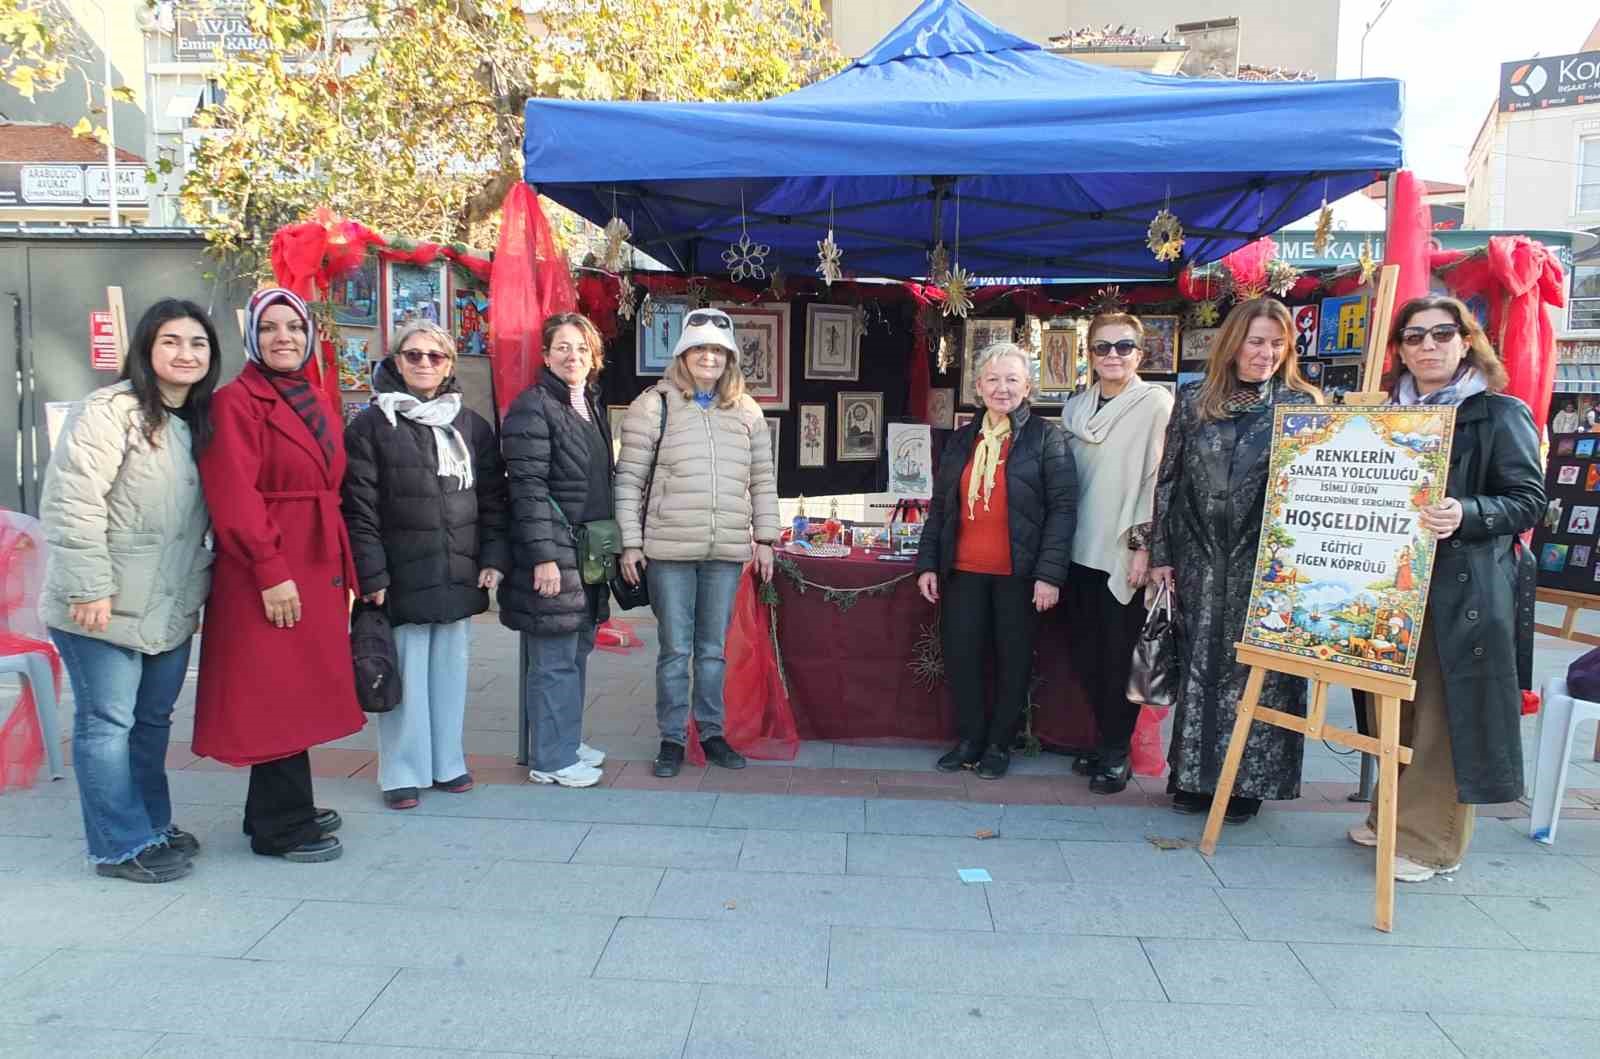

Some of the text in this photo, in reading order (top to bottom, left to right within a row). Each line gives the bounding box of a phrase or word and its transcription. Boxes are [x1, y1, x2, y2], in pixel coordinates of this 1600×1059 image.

[100, 171, 136, 184] AKAT
[1315, 448, 1395, 464] RENKLERİN
[1289, 465, 1419, 481] SANATA YOLCULUĞU
[1351, 483, 1379, 494] ÜRÜN
[1285, 508, 1411, 535] HOŞGELDİNİZ
[1320, 540, 1362, 556] EĞİTİCİ
[1296, 552, 1387, 574] FİGEN KÖPRÜLÜ
